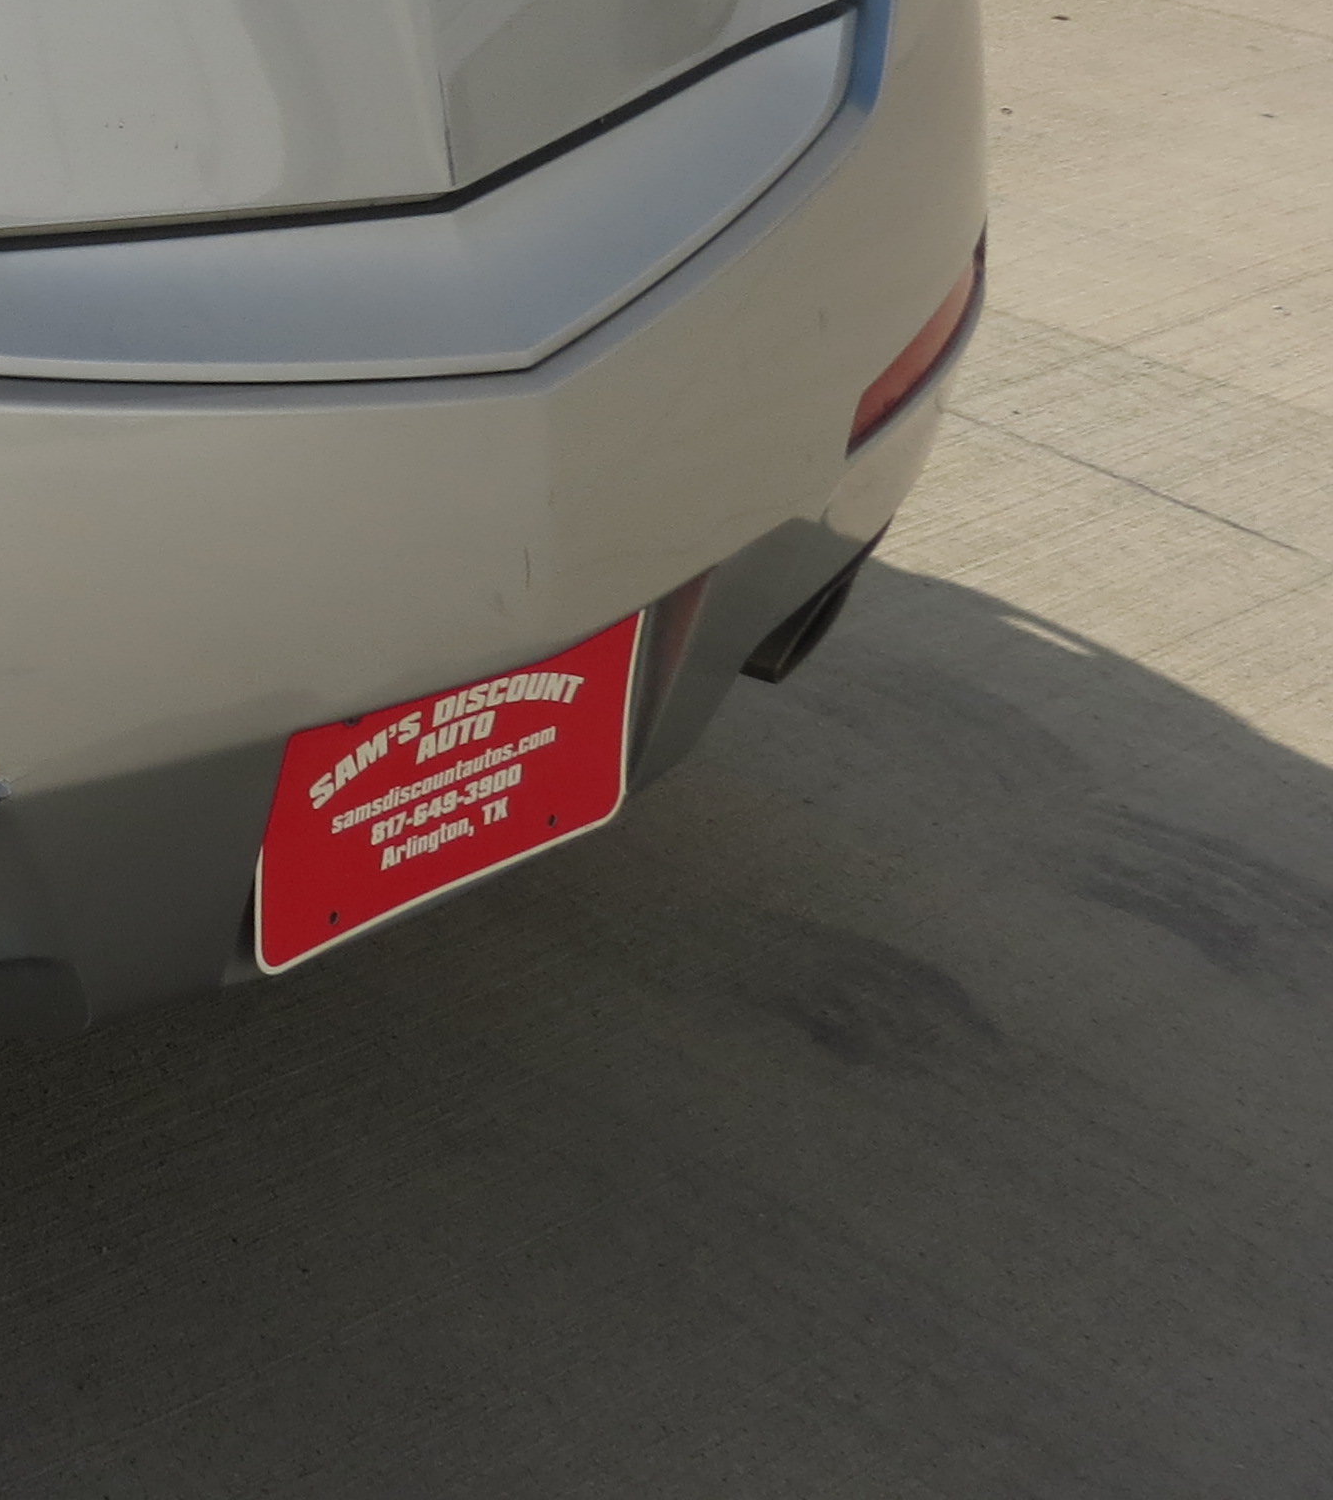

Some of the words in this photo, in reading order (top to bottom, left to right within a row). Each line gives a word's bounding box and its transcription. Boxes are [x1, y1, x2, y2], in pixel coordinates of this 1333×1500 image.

[308, 711, 422, 810] SAM'S
[432, 672, 585, 728] DISCOUNT
[415, 710, 497, 765] AUTO
[331, 725, 557, 834] samsdiscountautos.com
[370, 764, 523, 845] 817-649-3900
[379, 816, 475, 871] Arlington,
[481, 796, 509, 825] TX
